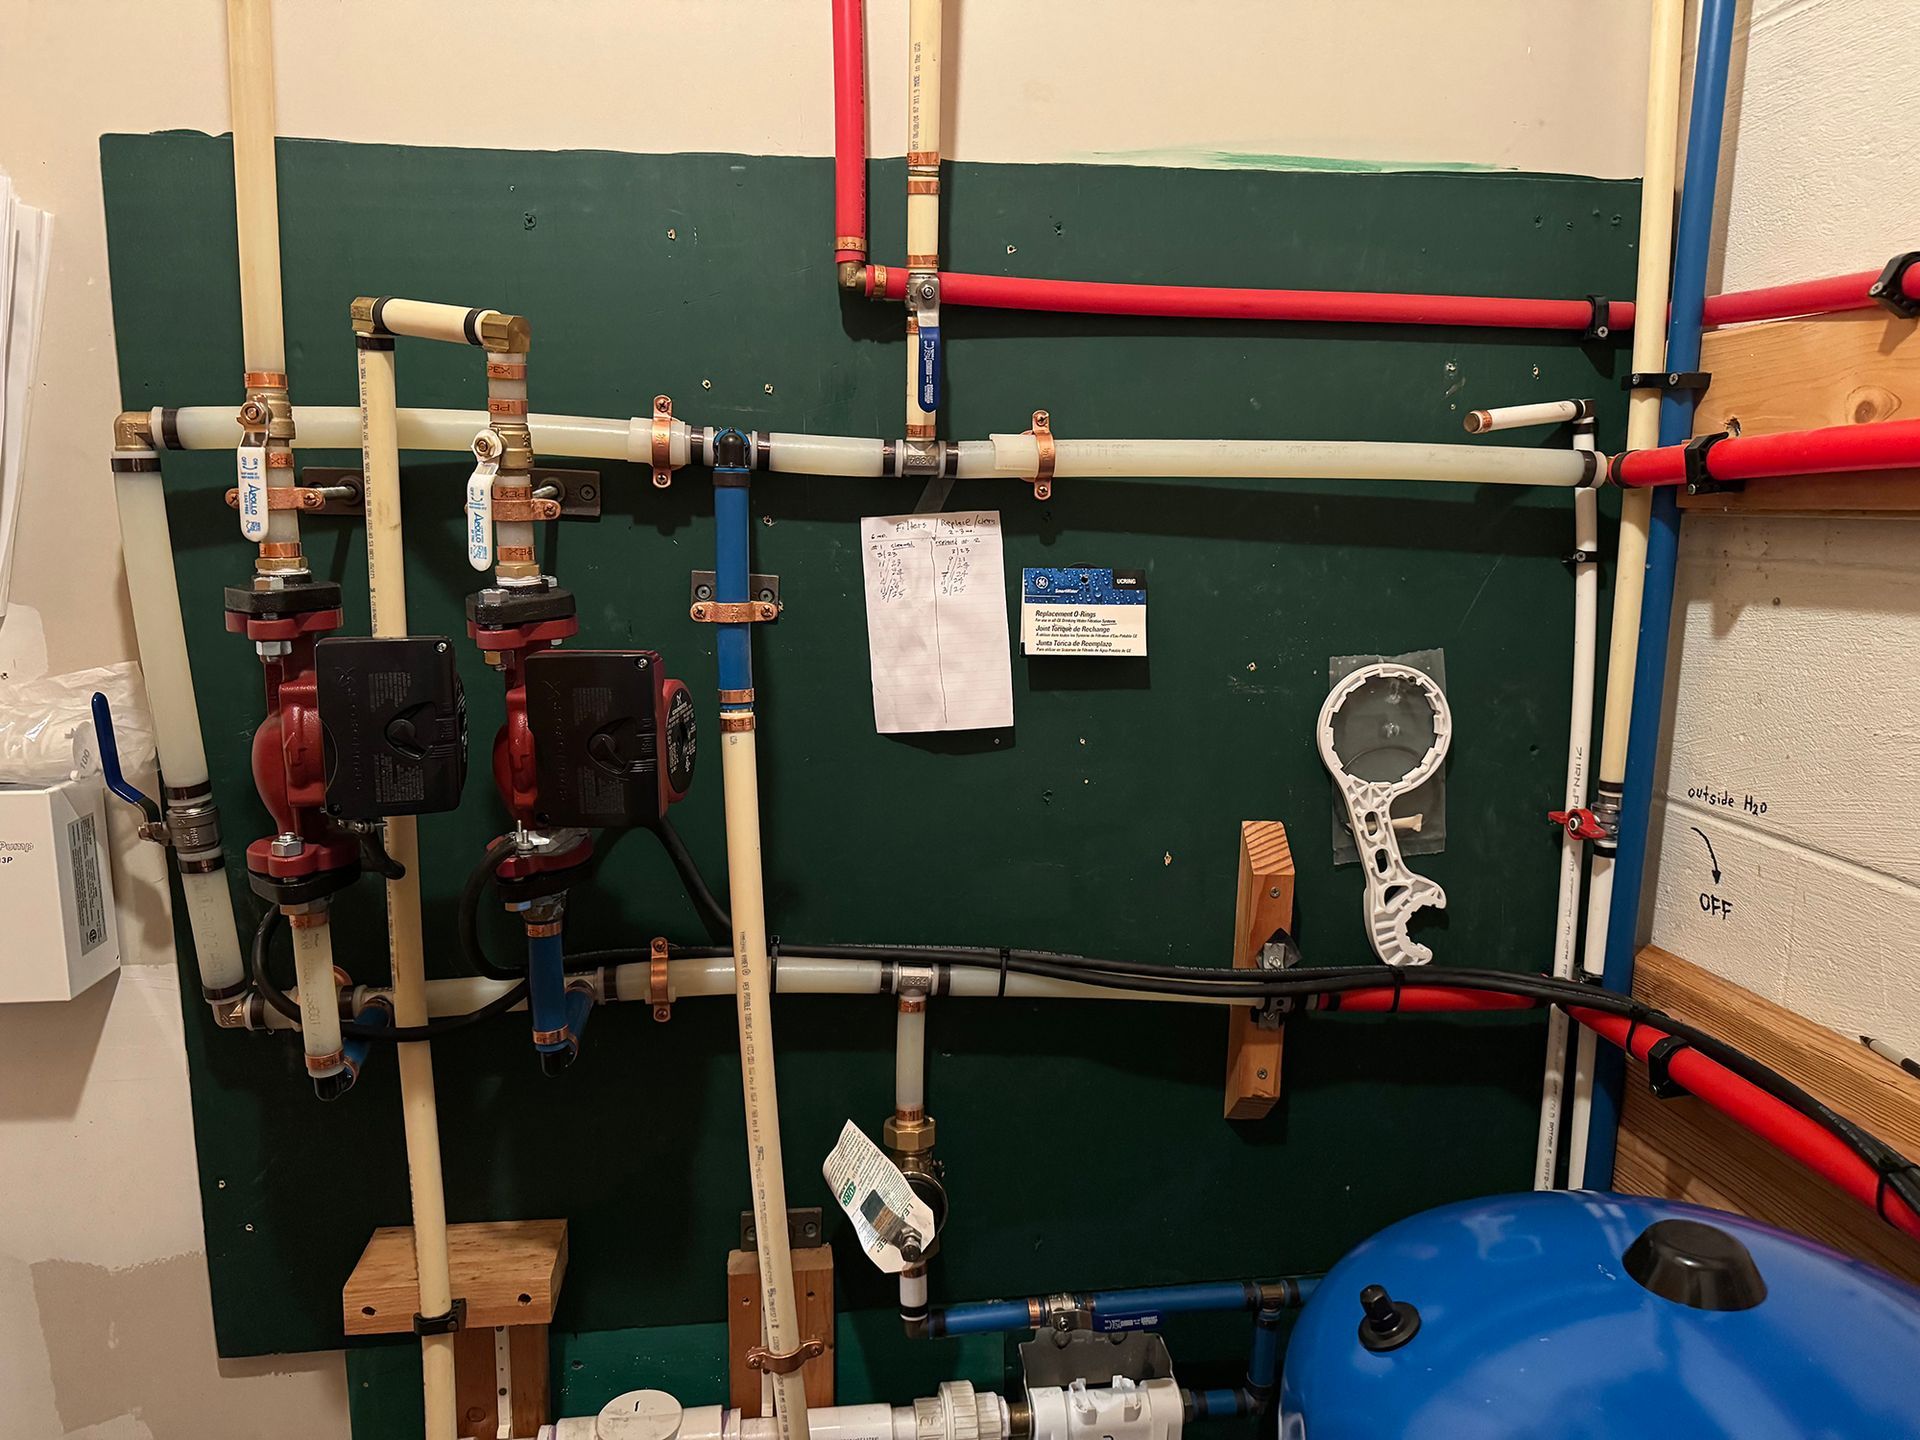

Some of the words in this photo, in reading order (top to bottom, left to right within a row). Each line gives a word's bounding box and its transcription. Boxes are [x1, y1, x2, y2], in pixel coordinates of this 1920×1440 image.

[1081, 640, 1112, 648] Reemplazo
[1688, 785, 1734, 808] outside
[1700, 893, 1733, 920] OFF
